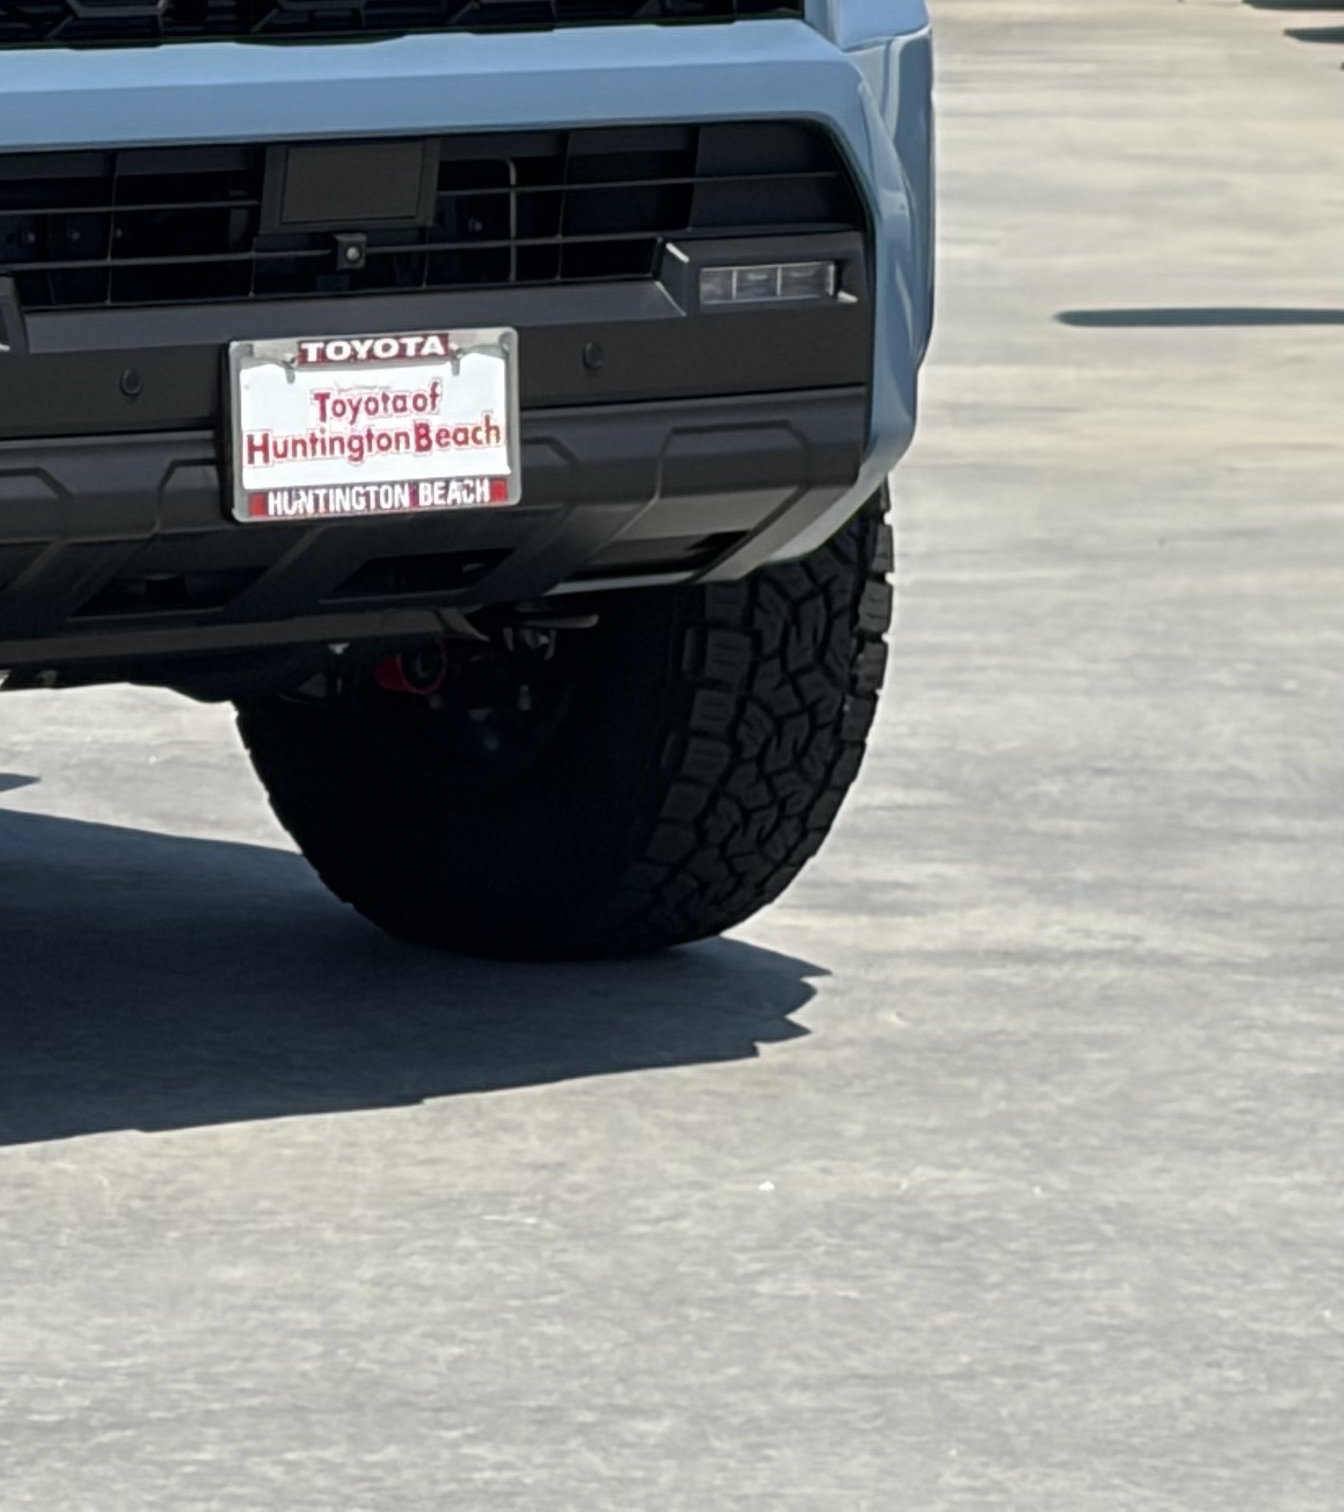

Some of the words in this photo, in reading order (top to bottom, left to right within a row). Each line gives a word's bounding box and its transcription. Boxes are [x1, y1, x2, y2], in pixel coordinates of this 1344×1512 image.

[301, 336, 445, 362] TOYOTA
[314, 392, 408, 425] Toyota
[414, 380, 440, 413] of
[247, 426, 411, 465] Huntington
[415, 414, 501, 452] Beach
[267, 484, 411, 517] HUNTINGTON
[419, 480, 491, 507] BEACH
